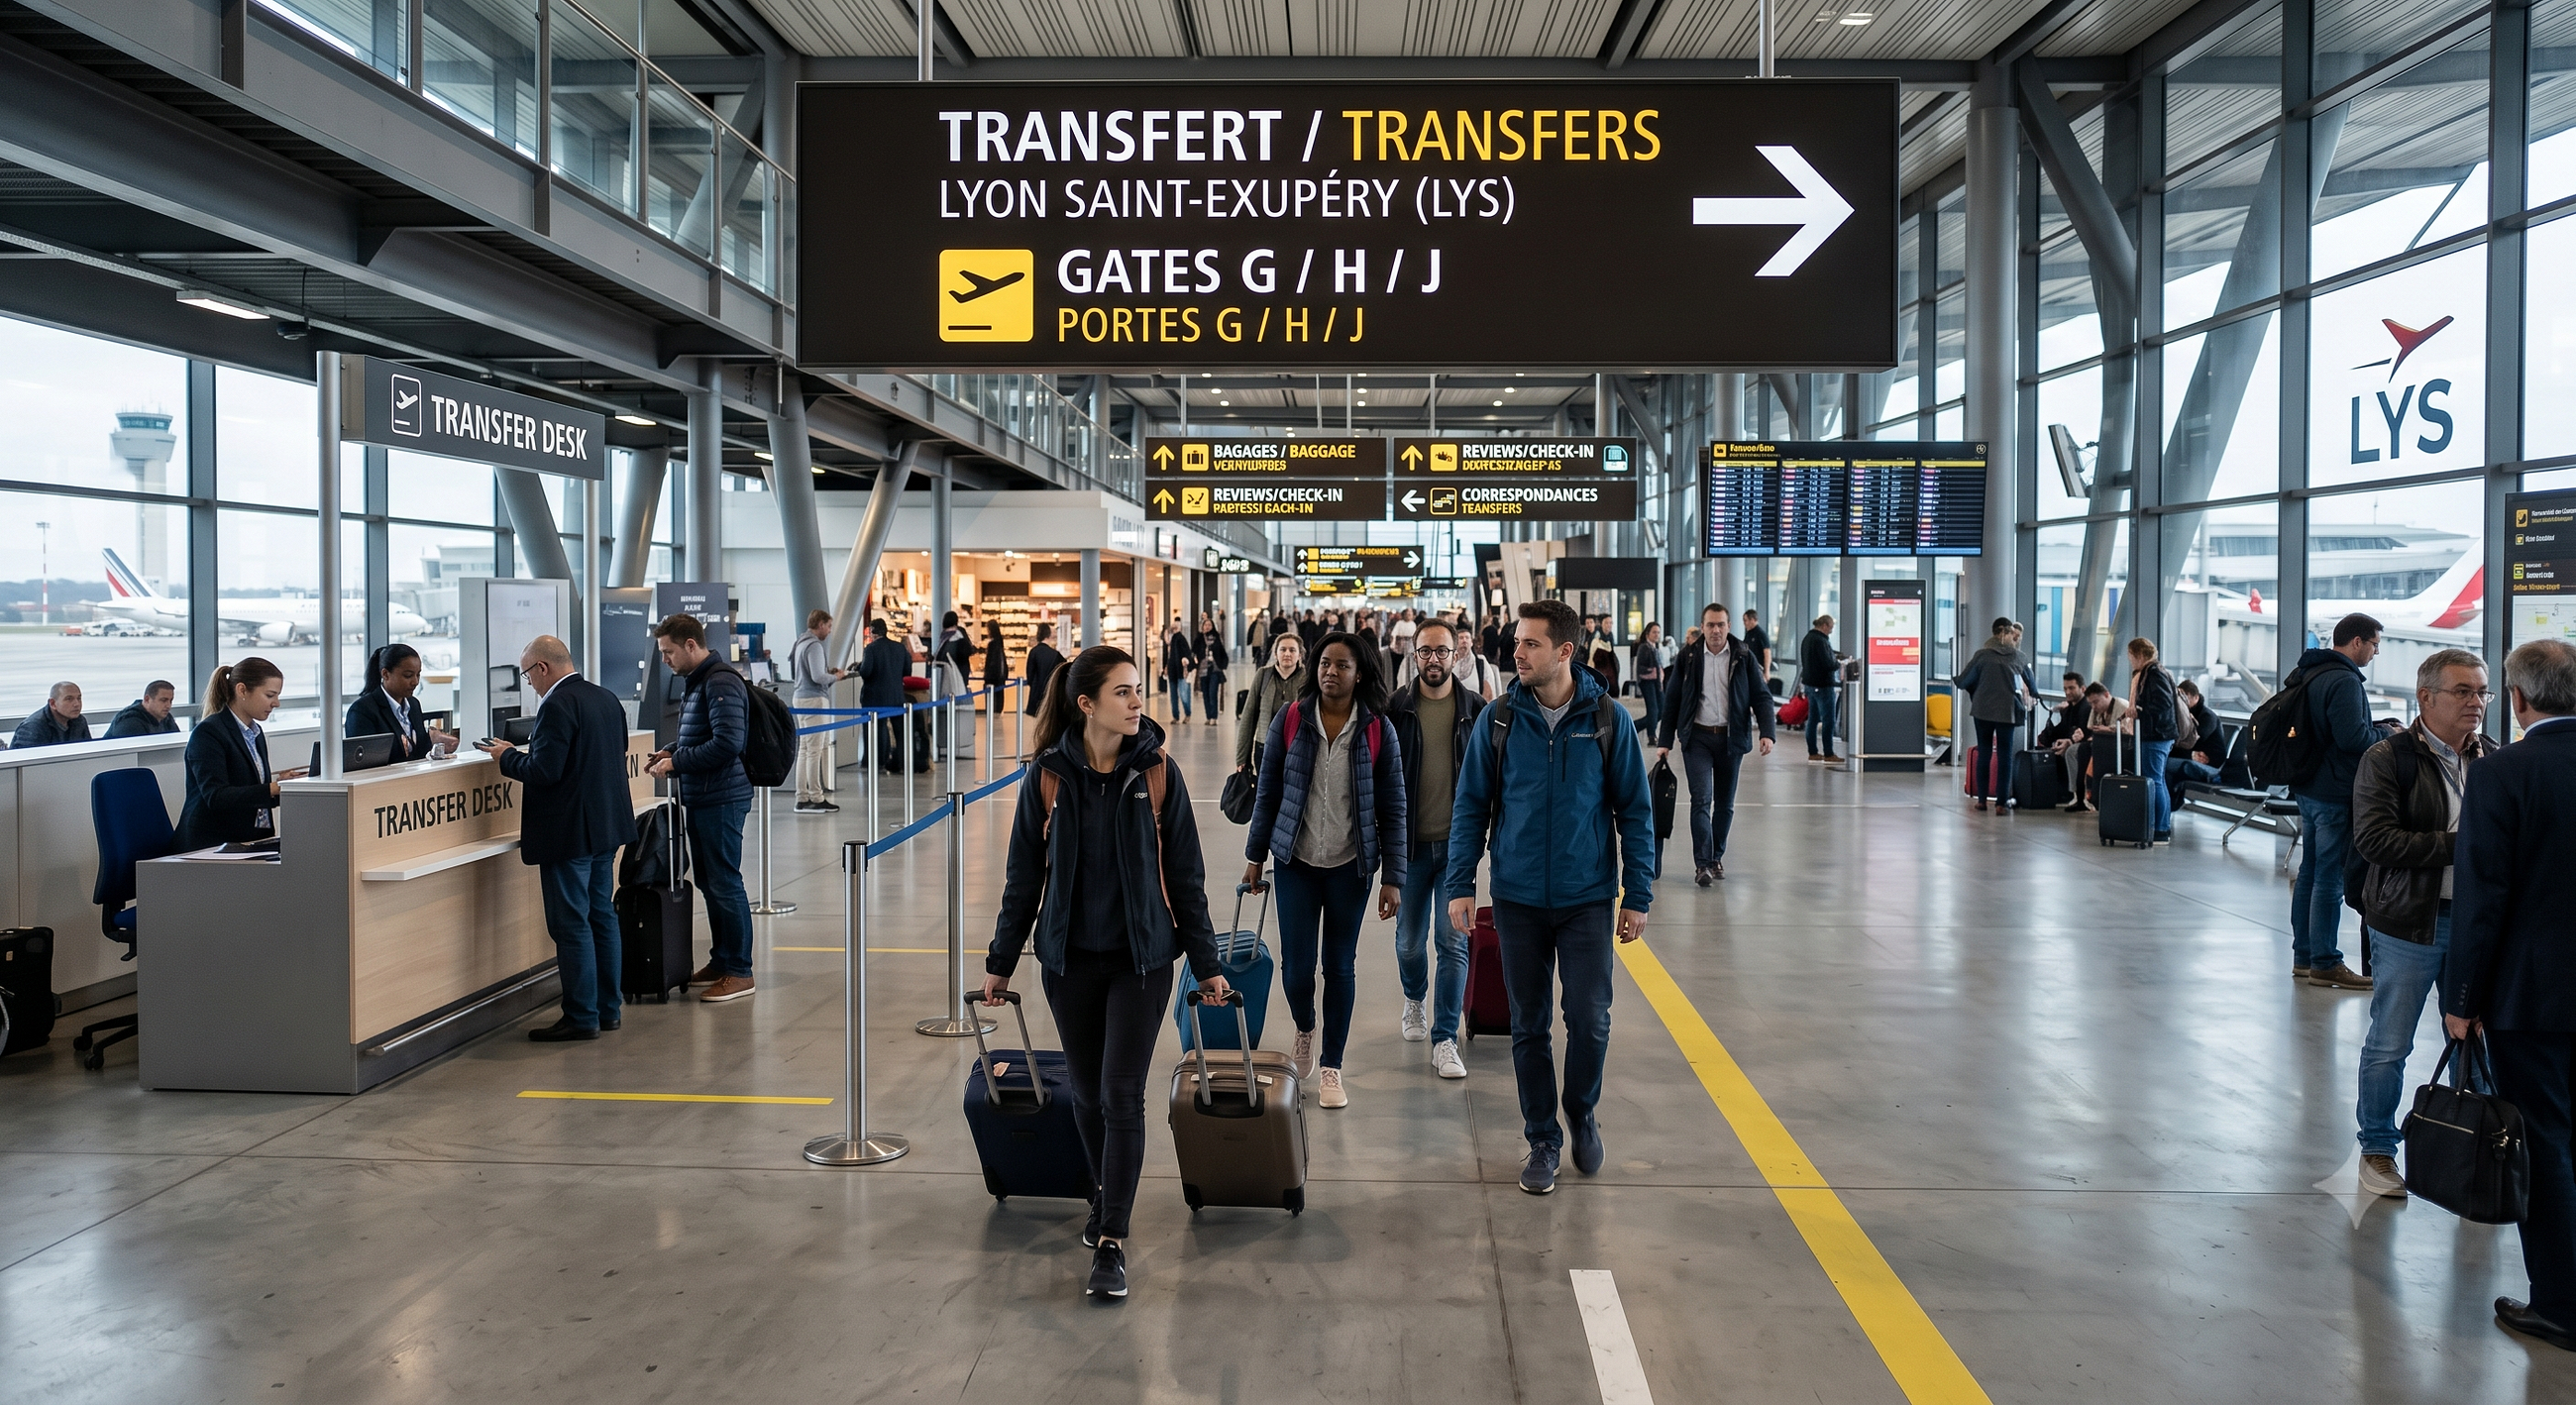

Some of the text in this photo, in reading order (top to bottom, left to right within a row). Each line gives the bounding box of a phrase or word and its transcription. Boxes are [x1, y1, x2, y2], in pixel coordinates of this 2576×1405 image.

[939, 109, 1662, 162] TRANSFERT / TRANSFERS
[940, 168, 1516, 225] LYON SAINT-EXUPÉRY (LYS)
[1057, 249, 1441, 294] GATES G / H / J
[1058, 307, 1363, 343] PORTES G / H / J
[430, 394, 588, 461] TRANSFER DESK
[2351, 378, 2454, 465] LYS
[1214, 444, 1356, 459] BAGAGES / BAGGAGE
[1462, 444, 1594, 459] REVIEWS/CHECK-IN
[1214, 487, 1343, 502] REVIEWS/CHECK-IN
[1461, 487, 1598, 502] CORRESPONDANCES
[374, 781, 514, 839] TRANSFER DESK
